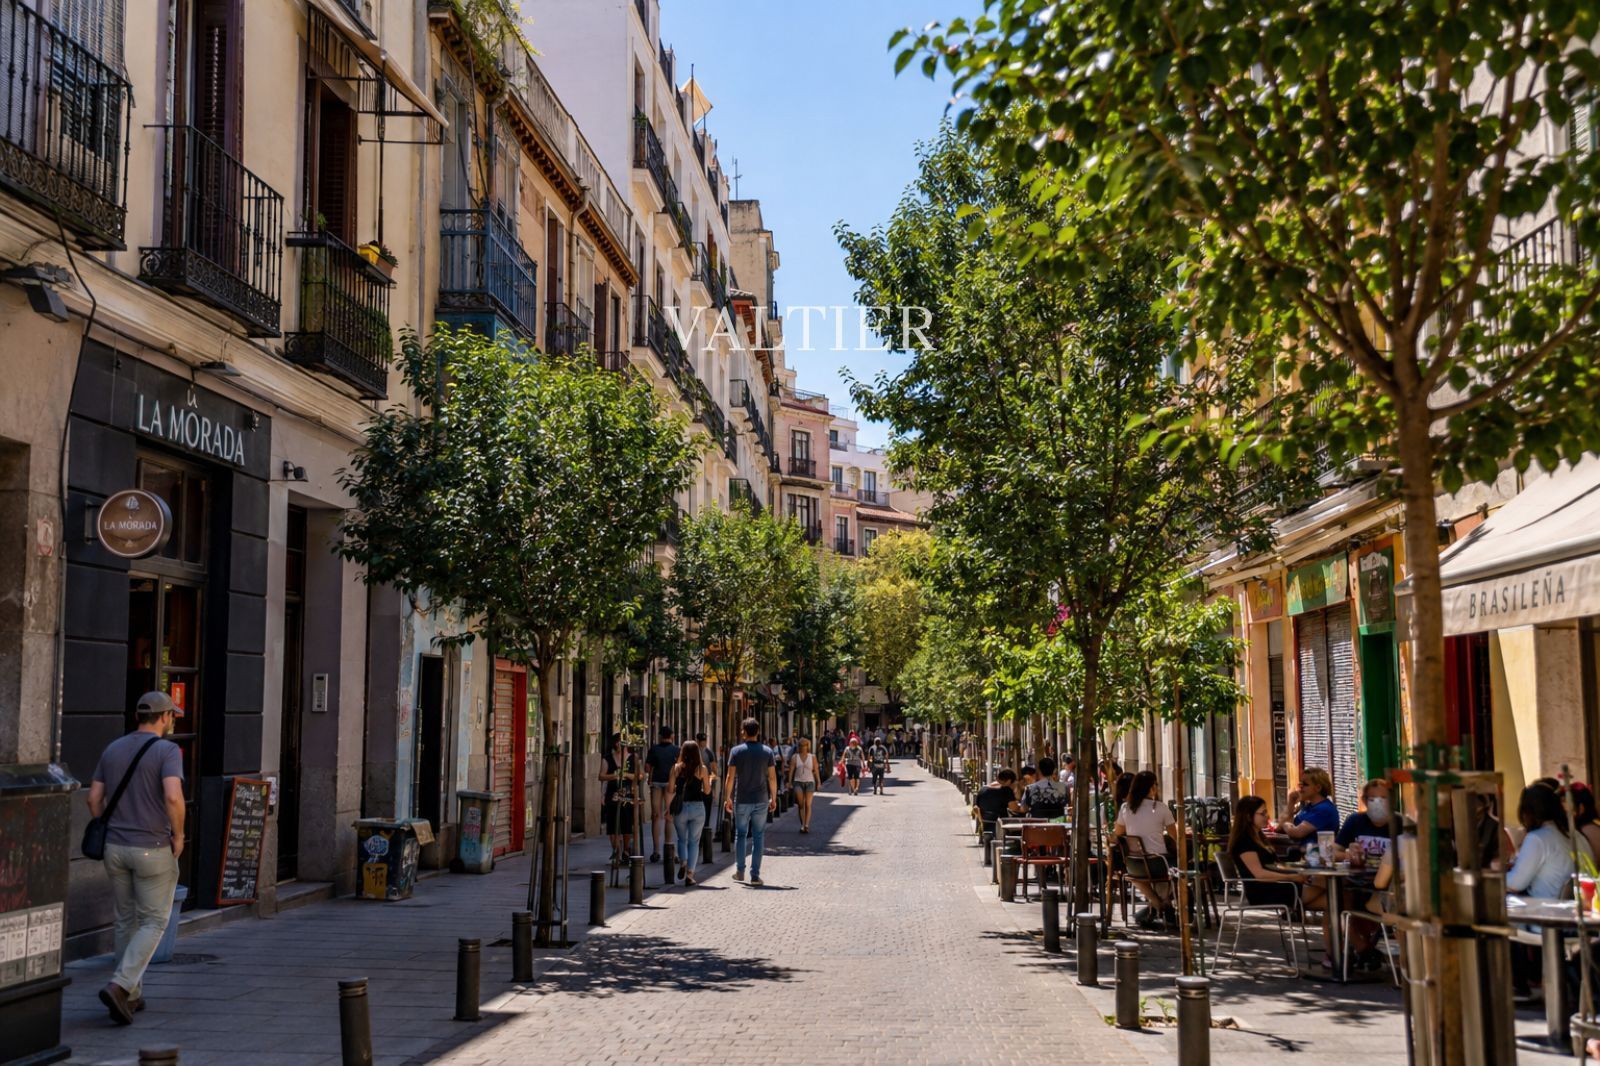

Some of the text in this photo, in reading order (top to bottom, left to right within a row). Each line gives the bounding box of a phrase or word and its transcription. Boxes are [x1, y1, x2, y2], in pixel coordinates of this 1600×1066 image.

[138, 394, 246, 466] LA MORADA
[104, 521, 157, 530] LA MORADA
[1469, 570, 1566, 619] BRASILEÑA
